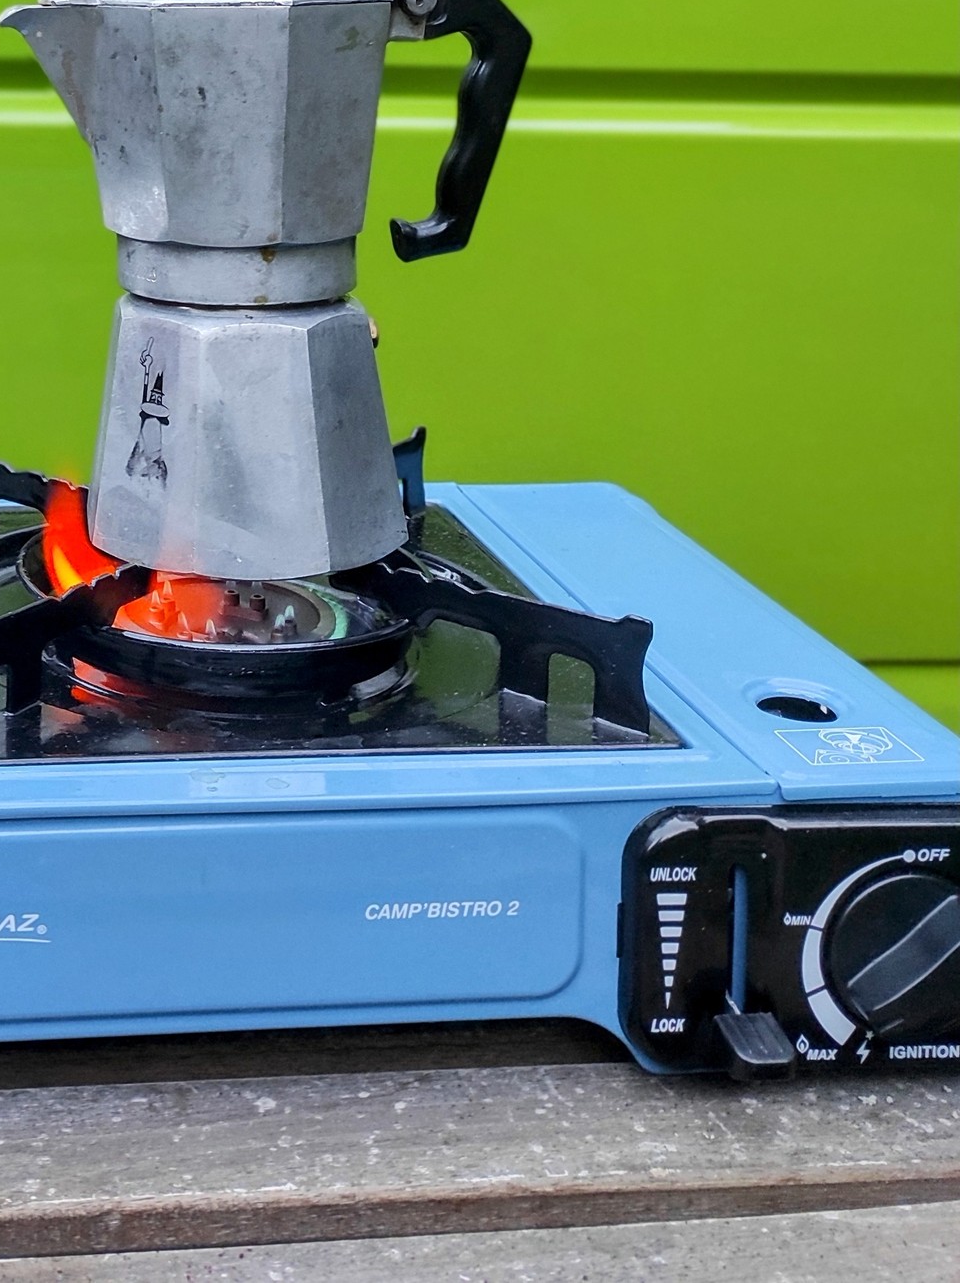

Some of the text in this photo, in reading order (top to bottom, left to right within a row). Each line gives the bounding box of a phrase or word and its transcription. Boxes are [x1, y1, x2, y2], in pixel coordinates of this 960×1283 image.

[917, 848, 951, 862] OFF
[650, 867, 698, 882] UNLOCK
[365, 900, 520, 920] CAMP'BISTRO 2
[791, 915, 812, 926] MIN
[650, 1018, 686, 1033] LOCK
[806, 1049, 838, 1061] MAX
[889, 1045, 960, 1059] IGNITION
